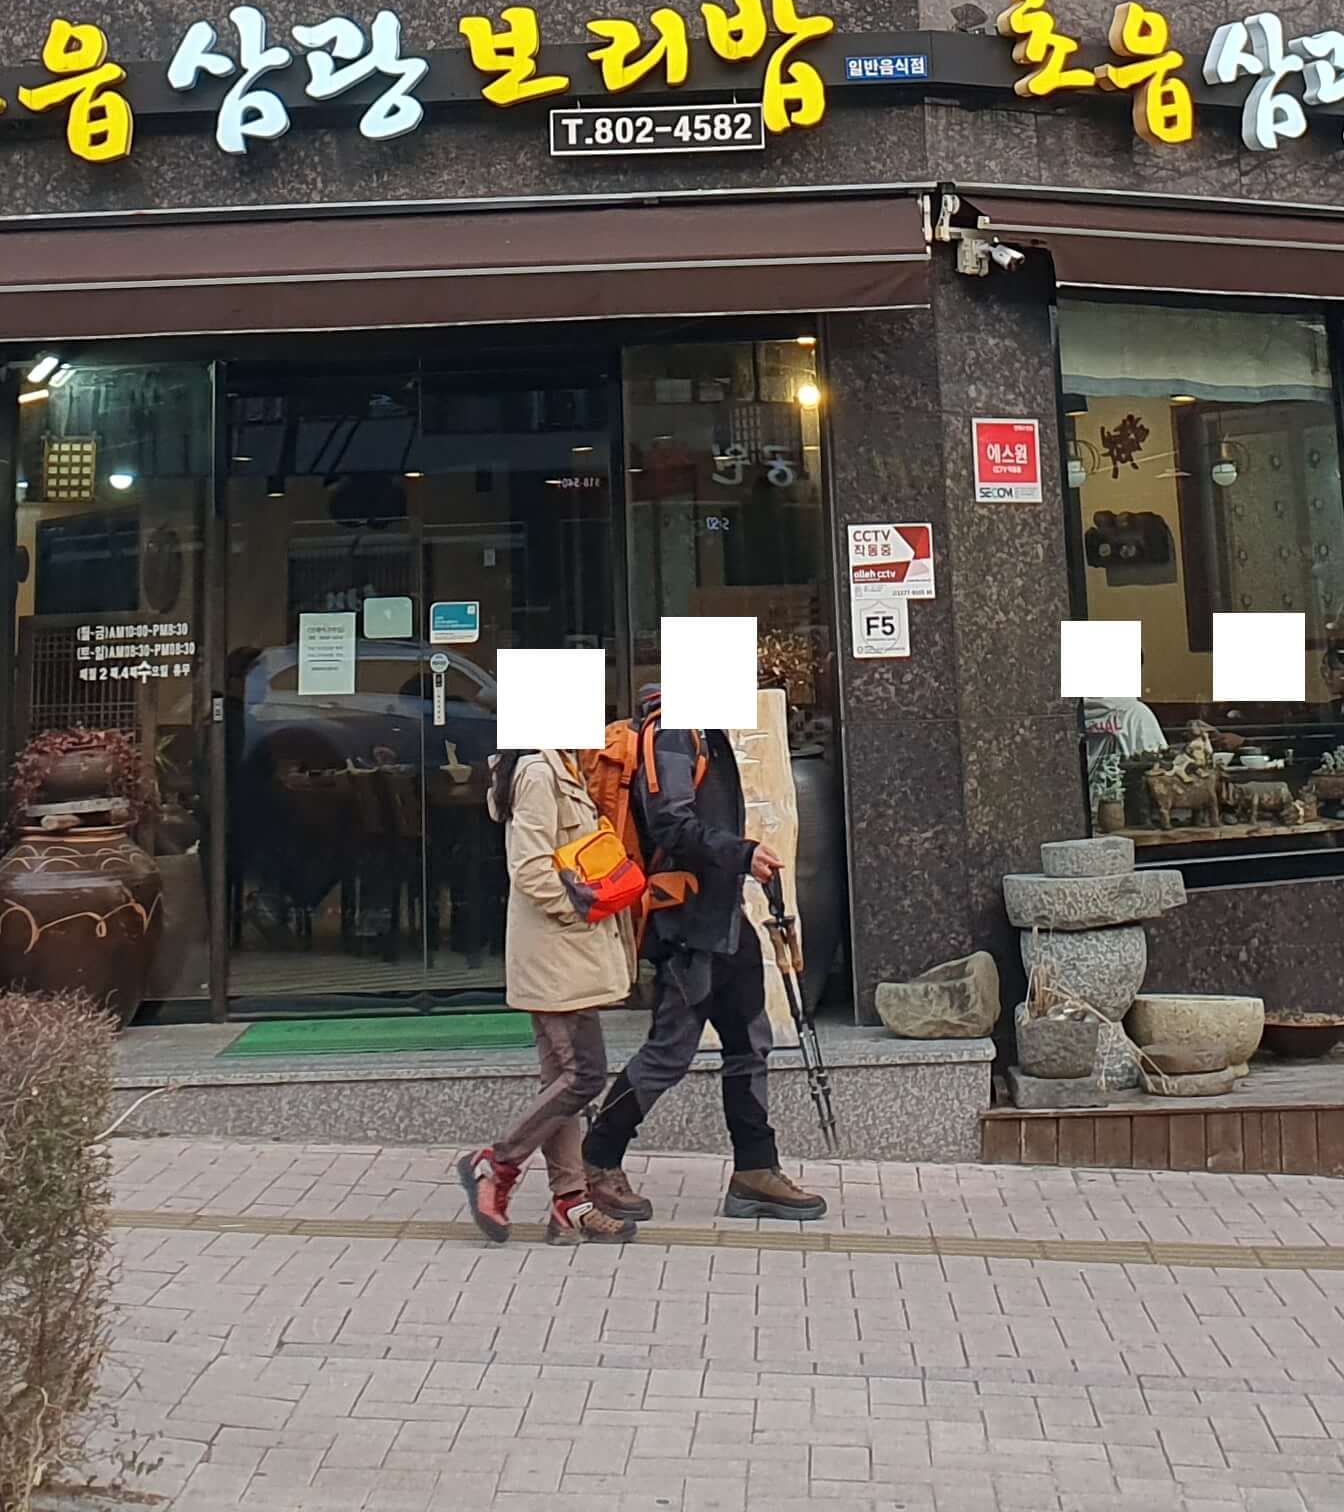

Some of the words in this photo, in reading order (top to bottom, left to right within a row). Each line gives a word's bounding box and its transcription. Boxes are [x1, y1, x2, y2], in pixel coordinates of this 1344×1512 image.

[848, 56, 925, 77] 일반음식점
[168, 6, 427, 154] 삼광
[560, 113, 752, 145] T.802-4582
[986, 443, 1029, 465] 에스원
[979, 487, 1013, 499] SECOM
[852, 529, 891, 543] CCTV
[865, 615, 895, 637] F5
